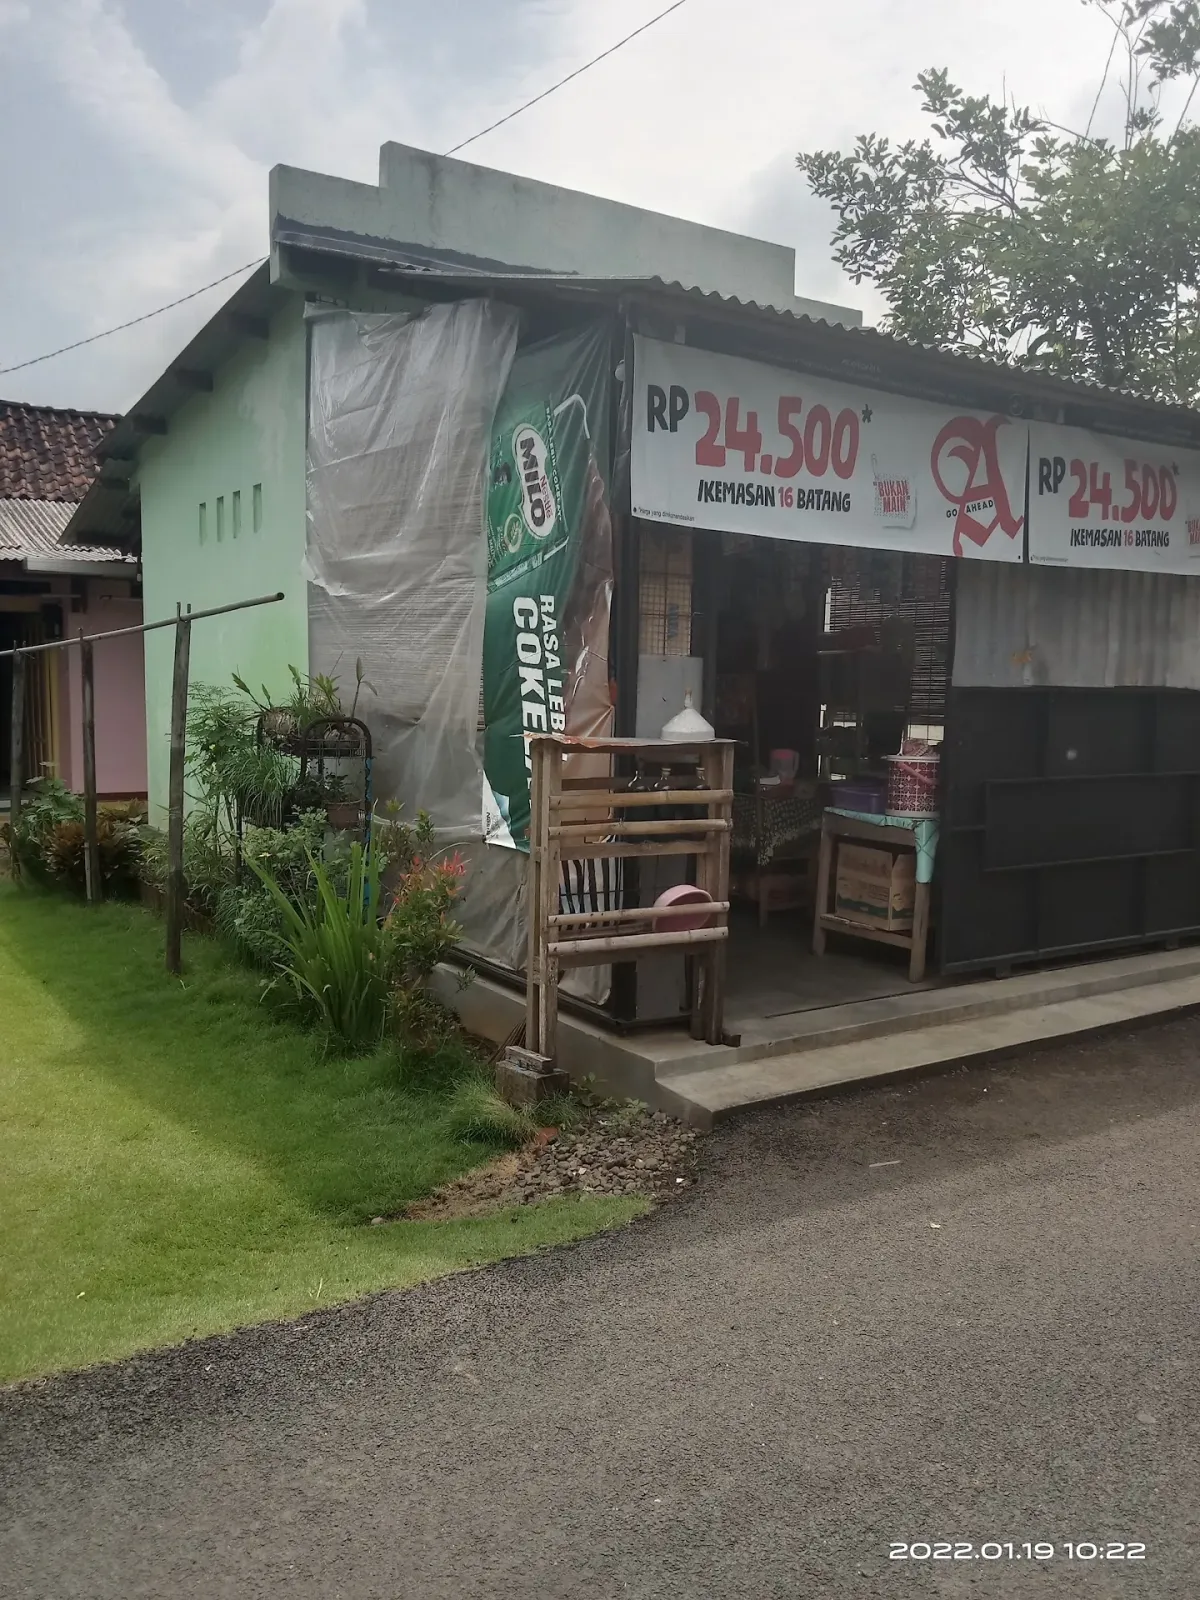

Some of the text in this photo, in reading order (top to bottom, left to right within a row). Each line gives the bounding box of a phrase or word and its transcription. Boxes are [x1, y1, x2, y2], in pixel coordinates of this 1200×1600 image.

[647, 384, 690, 433] RP
[519, 436, 547, 528] MILO
[1038, 456, 1066, 495] RP
[777, 486, 793, 508] 16
[796, 488, 851, 513] BATANG
[946, 500, 994, 518] GO AHEAD
[1123, 530, 1134, 546] 16
[1135, 529, 1170, 548] BATANG
[539, 594, 567, 761] RASA LEB
